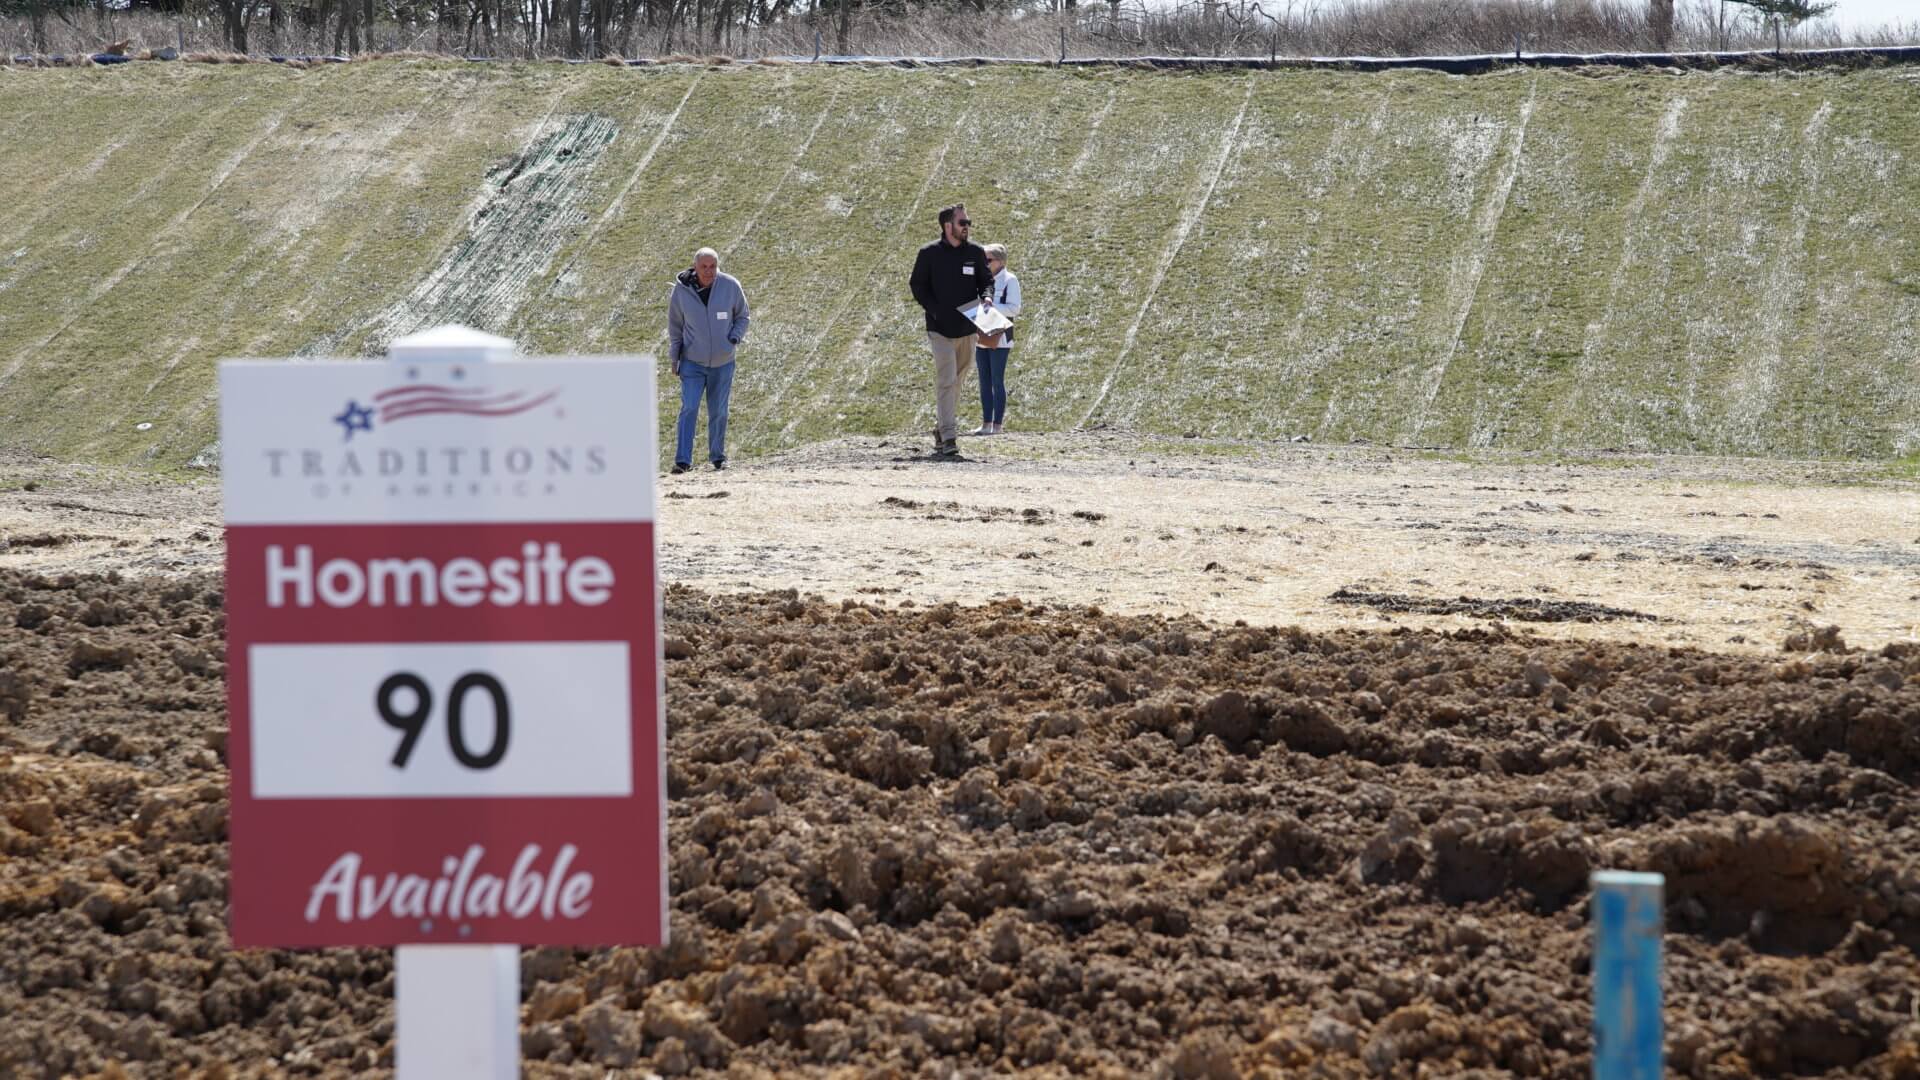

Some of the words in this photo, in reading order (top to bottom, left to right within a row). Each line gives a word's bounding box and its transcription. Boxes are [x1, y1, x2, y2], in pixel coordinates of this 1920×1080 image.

[264, 446, 608, 478] TRADITIONS
[265, 541, 615, 608] Homesite
[375, 671, 511, 771] 90
[304, 842, 594, 923] Available
